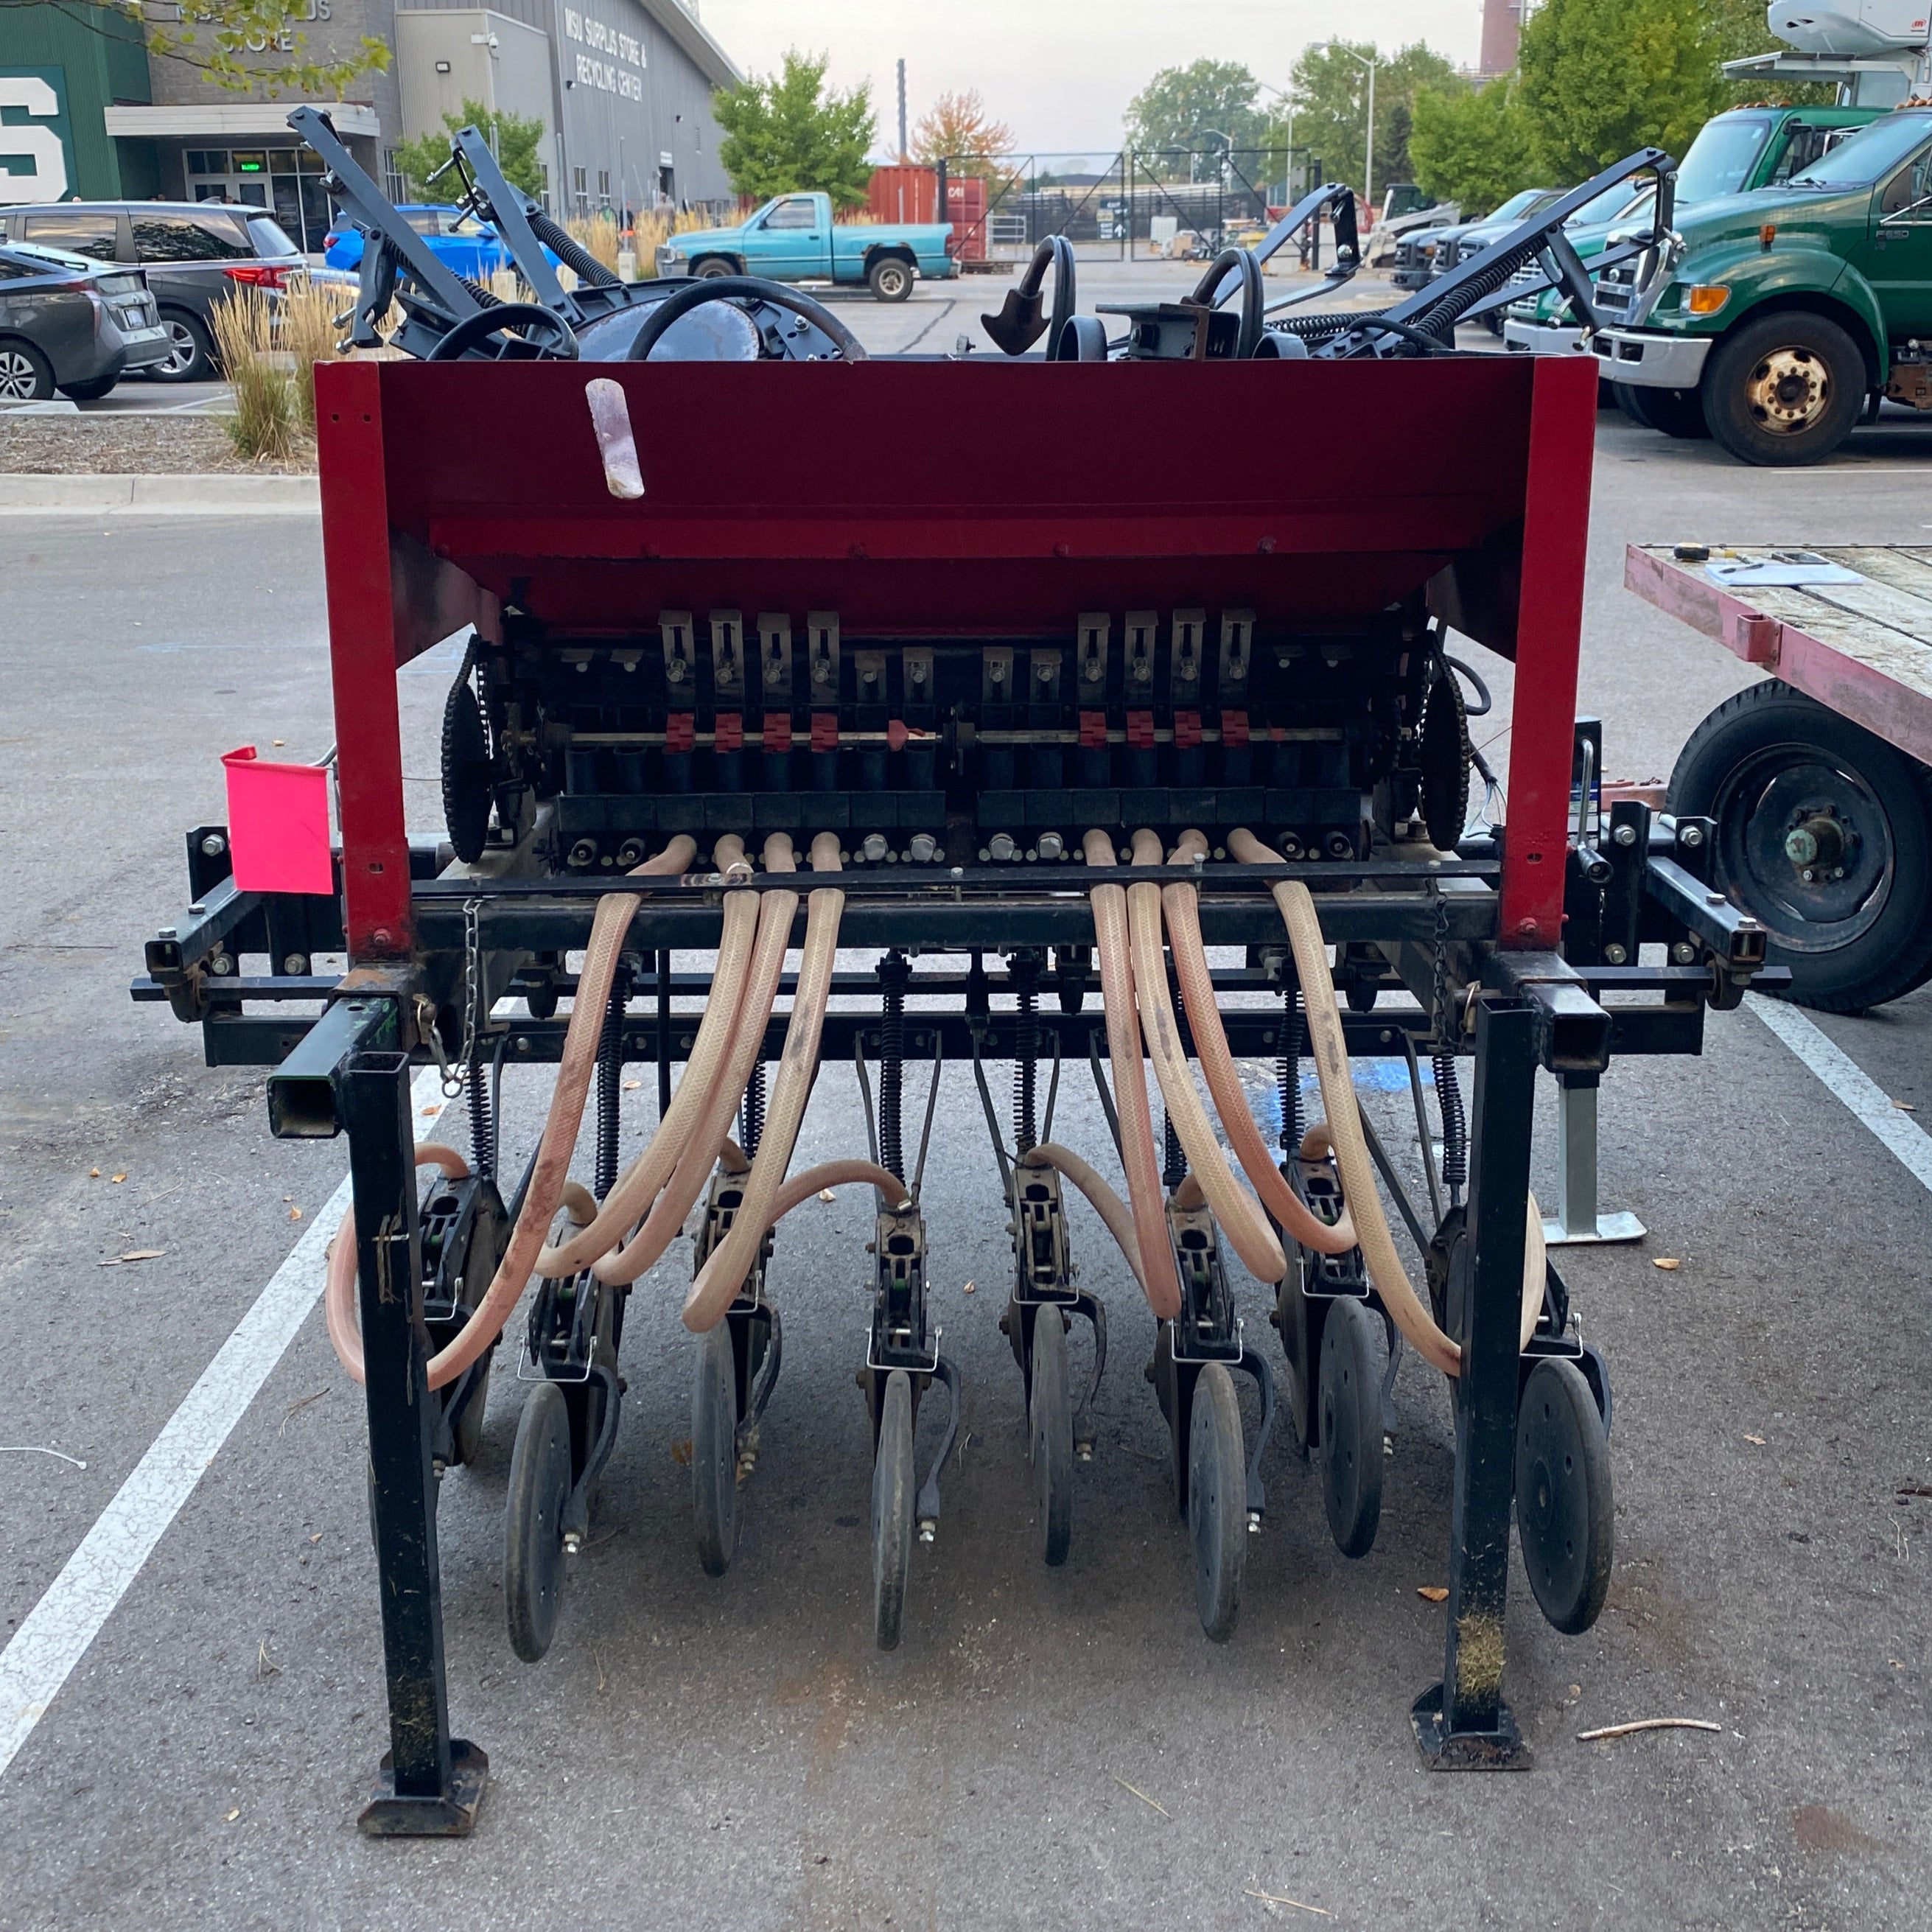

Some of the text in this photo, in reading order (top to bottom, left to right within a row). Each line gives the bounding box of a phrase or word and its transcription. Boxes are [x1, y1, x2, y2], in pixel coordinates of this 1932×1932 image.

[564, 7, 583, 42] MSU
[585, 17, 617, 56] SURPLUS
[619, 32, 640, 66] STORE
[576, 54, 643, 102] RECYCLING CENTER
